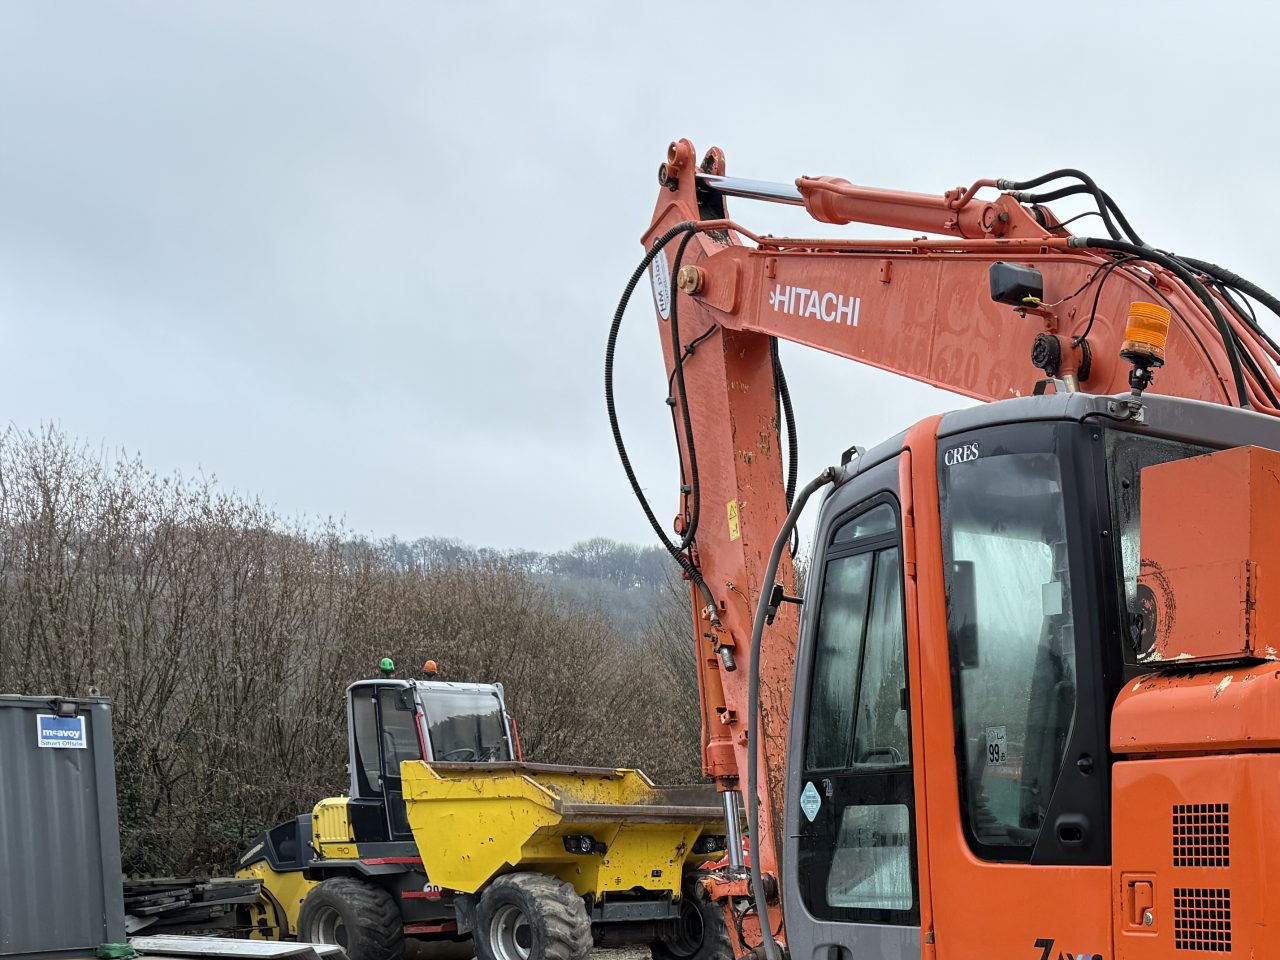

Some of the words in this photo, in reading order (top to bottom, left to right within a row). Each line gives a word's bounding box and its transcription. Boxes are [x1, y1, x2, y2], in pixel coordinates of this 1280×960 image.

[774, 284, 861, 327] HITACHI
[944, 442, 979, 466] CRES
[989, 743, 1000, 763] 99
